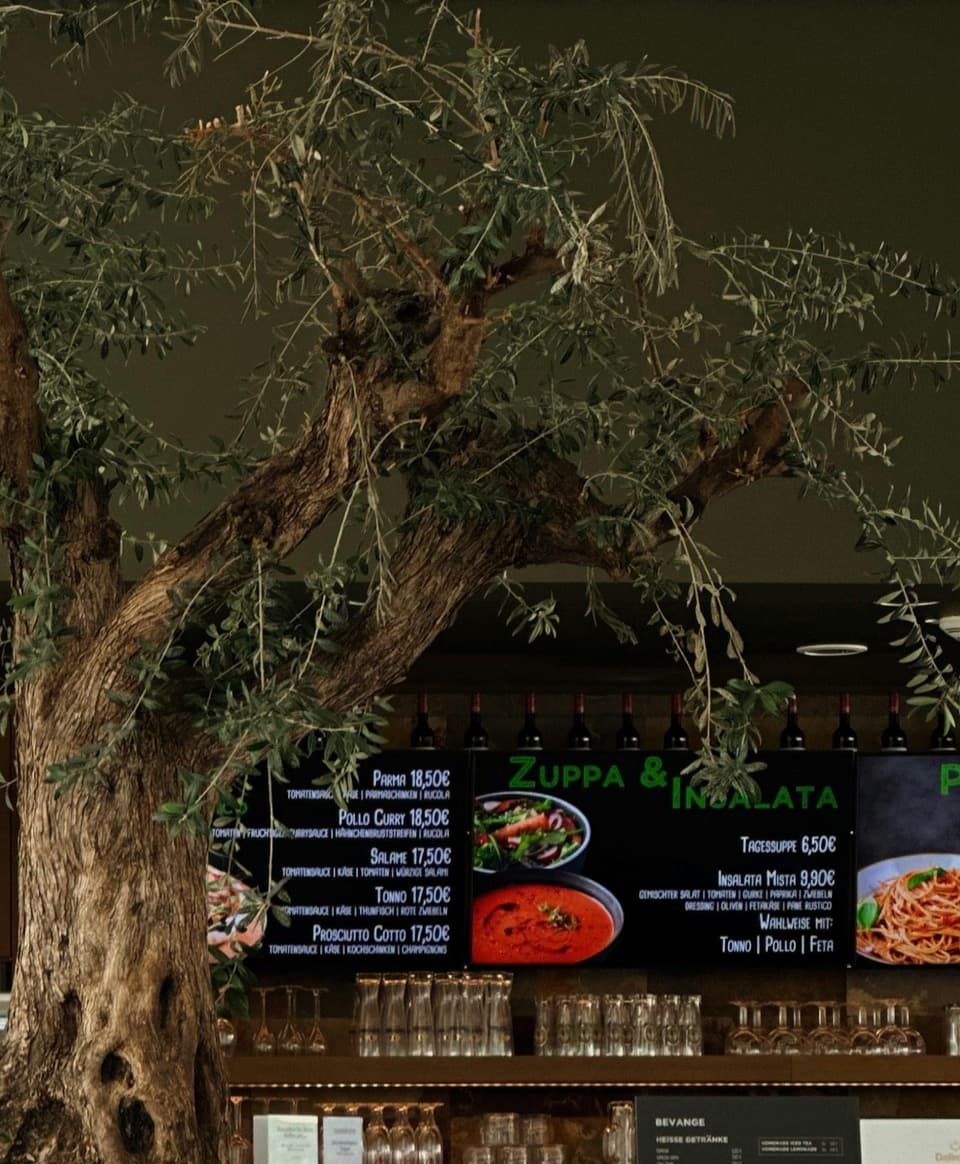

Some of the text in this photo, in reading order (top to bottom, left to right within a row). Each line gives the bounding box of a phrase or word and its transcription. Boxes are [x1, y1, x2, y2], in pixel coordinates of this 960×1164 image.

[373, 769, 450, 790] PARMA 18,50€
[508, 756, 667, 788] ZUPPA &
[287, 789, 335, 800] TOMATENSAUC
[424, 789, 450, 800] RUCOLA
[339, 808, 449, 829] POLLO CURRY 18,50€
[423, 828, 449, 838] RUCOLA
[740, 835, 836, 856] TAGESSUPPE 6,50€
[371, 847, 451, 867] SALAME 17,50€
[282, 867, 331, 877] TOMATENSAUCE
[337, 867, 353, 877] KÄSE
[360, 867, 389, 877] TOMATEN
[425, 867, 448, 877] SALAMI
[718, 869, 835, 889] INSALATA MISTA 9,90€
[375, 886, 451, 906] TONNO 17,50€
[639, 889, 833, 900] GEMISCHTER SALAT TOMATEN GURKE PAPRIKA ZWIEBELN
[283, 905, 448, 916] OMATENSAUCE KÄSE THUNFISCH ROTE ZWIEBELN
[685, 901, 832, 911] DRESSING OLIVEN FETAKÄSE PANE RUSTICO
[760, 913, 834, 930] WAHLWEISE MIT:
[313, 924, 450, 944] PROSCIUTTO COTTO 17,50€
[269, 944, 318, 954] TOMATENSAUCE
[325, 944, 340, 955] KÄSE
[720, 936, 834, 952] TONNO POLLO FETA
[655, 1118, 705, 1127] BEVANGE
[656, 1134, 728, 1144] HEISSE GETRÄNKE
